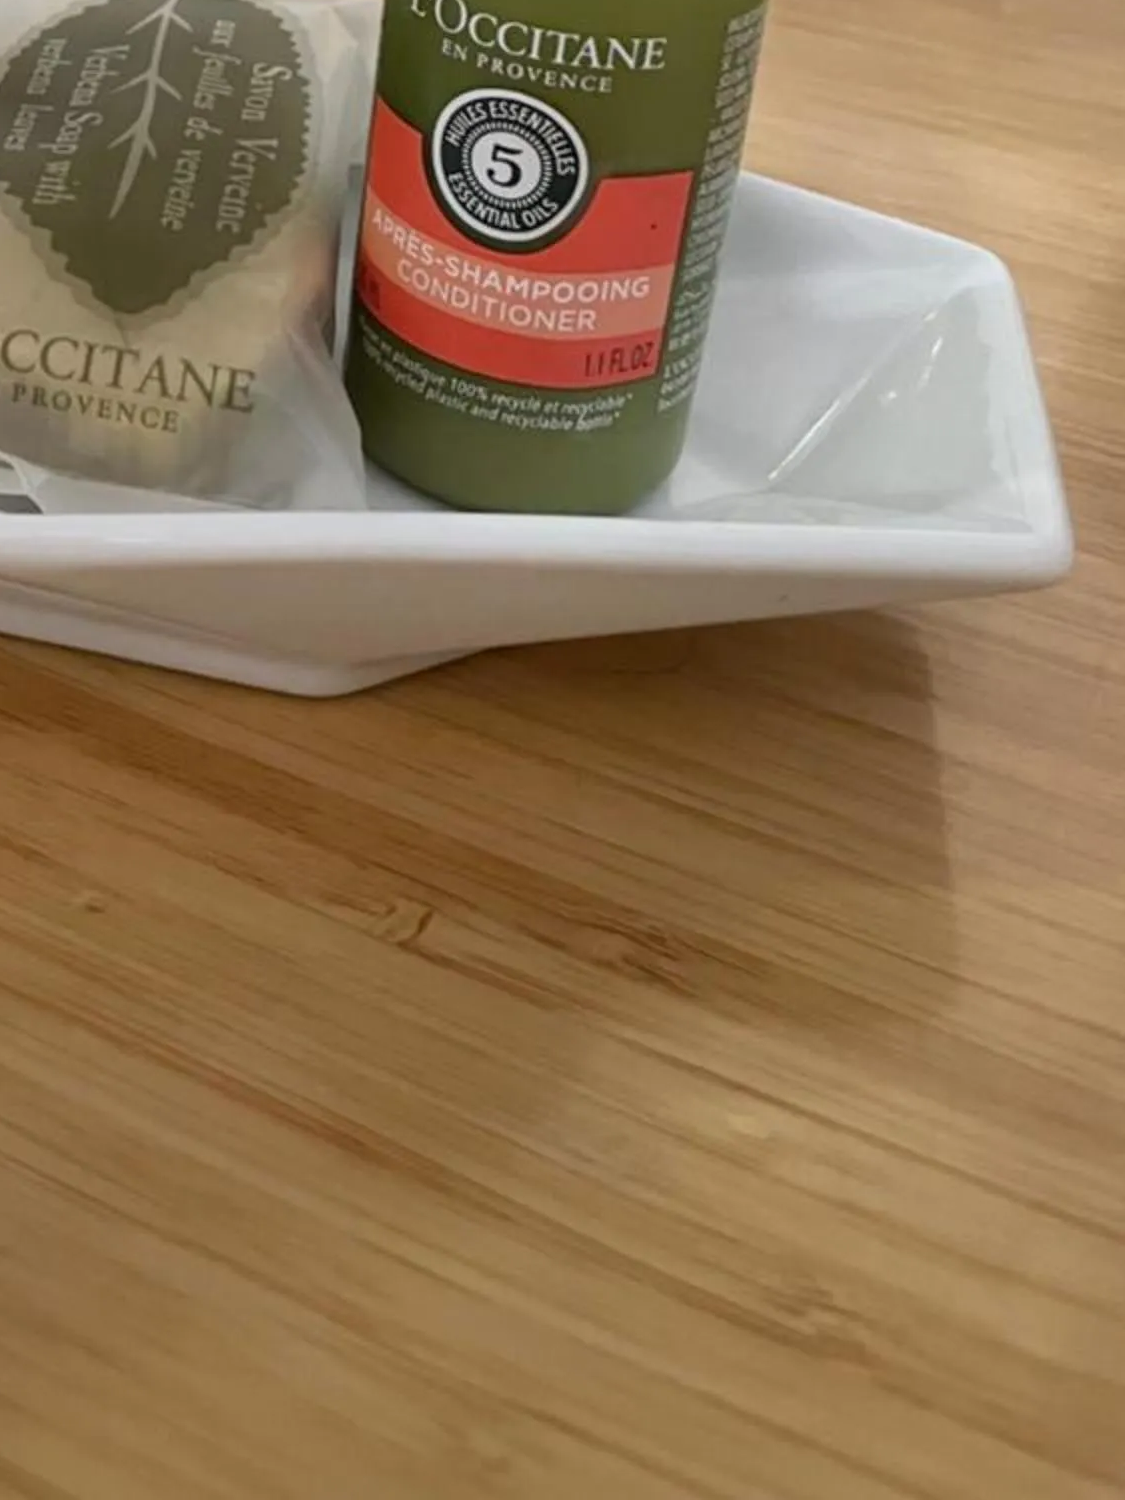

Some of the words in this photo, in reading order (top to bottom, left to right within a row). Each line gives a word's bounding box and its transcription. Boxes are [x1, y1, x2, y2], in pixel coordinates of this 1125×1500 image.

[240, 61, 293, 121] Savon
[442, 38, 467, 62] EN
[476, 51, 613, 93] PROVENCE
[36, 110, 104, 155] Soap
[183, 116, 223, 141] de
[444, 101, 488, 148] HUILES
[488, 100, 576, 176] ESSENTIELLES
[32, 160, 81, 205] with
[215, 137, 279, 234] Verveine
[485, 142, 524, 188] 5
[448, 171, 521, 229] ESSENTIAL
[521, 198, 559, 228] OILS
[371, 208, 651, 303] APRÈS-SHAMPOOING
[396, 258, 597, 332] CONDITIONER
[12, 382, 179, 434] PROVENCE
